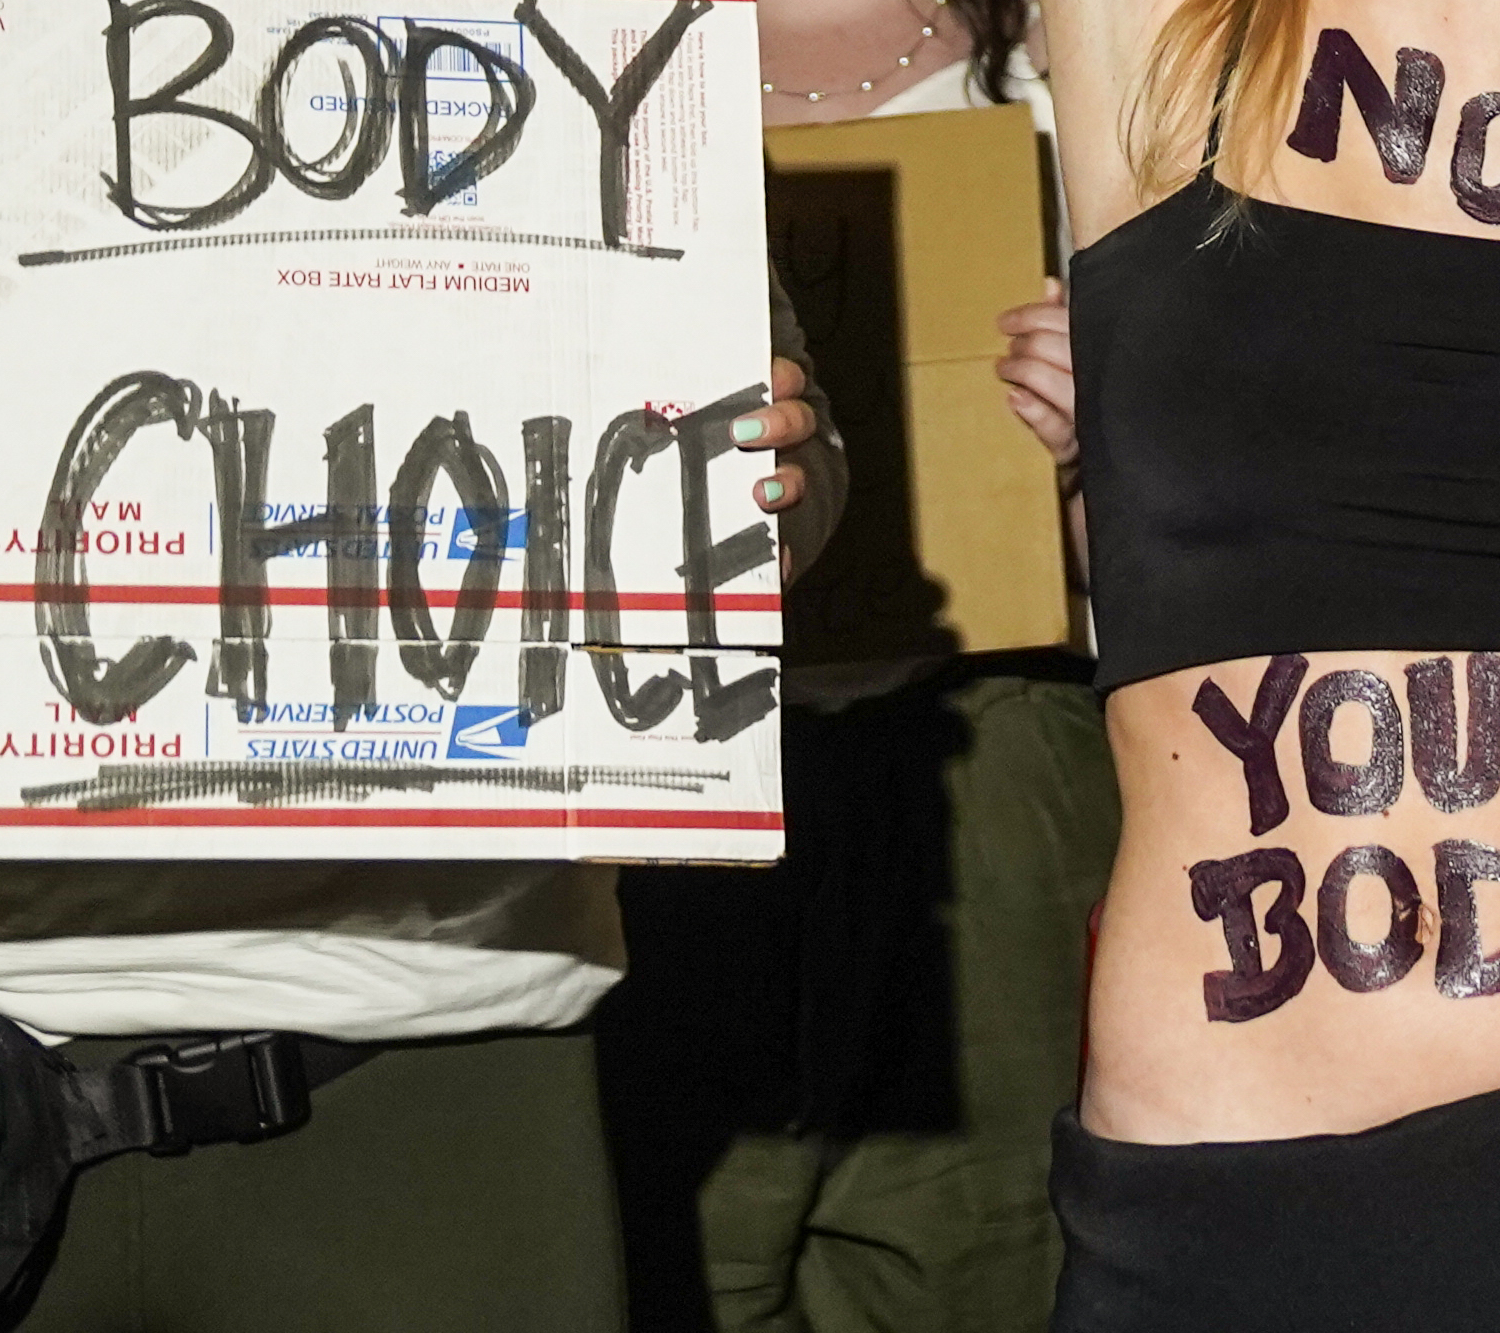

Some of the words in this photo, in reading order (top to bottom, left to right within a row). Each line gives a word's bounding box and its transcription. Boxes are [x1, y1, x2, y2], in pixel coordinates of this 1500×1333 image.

[277, 269, 322, 286] BOX
[328, 271, 381, 288] RATE
[387, 273, 437, 290] FLAT
[445, 275, 530, 293] MEDIUM
[34, 368, 777, 745] CHOICE
[246, 740, 336, 761] STATES
[341, 740, 438, 761] UNITED
